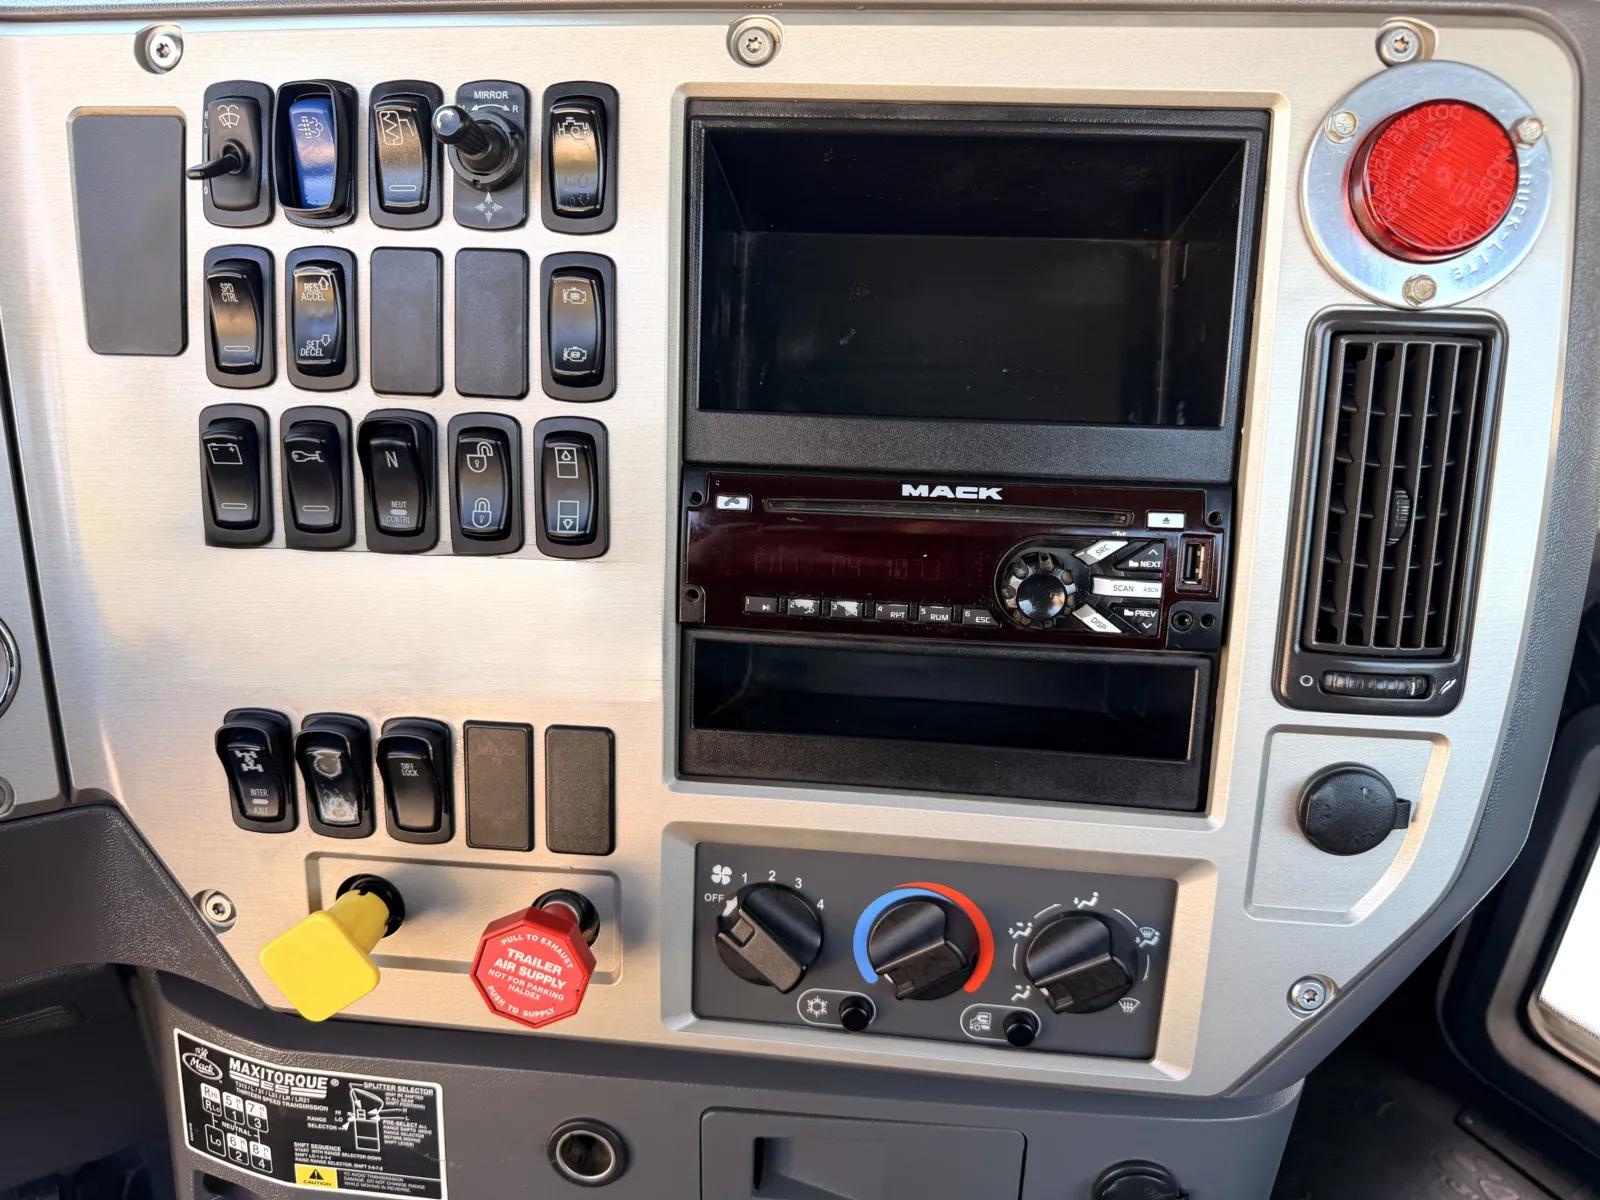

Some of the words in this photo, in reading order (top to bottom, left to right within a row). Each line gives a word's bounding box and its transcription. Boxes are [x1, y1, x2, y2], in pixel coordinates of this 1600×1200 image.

[474, 91, 508, 99] MIRROR
[220, 282, 234, 292] SPD
[222, 293, 238, 302] CTRL
[301, 292, 326, 300] ACCEL
[306, 340, 320, 348] SET
[300, 348, 324, 356] DECEL
[385, 451, 398, 468] N
[902, 484, 1003, 500] MACK
[1096, 544, 1110, 556] SRC
[1090, 617, 1107, 629] DISP
[742, 872, 748, 883] 1
[768, 870, 776, 881] 2
[795, 878, 802, 888] 3
[704, 893, 724, 902] OFF
[817, 899, 824, 910] 4
[501, 934, 524, 945] PULL
[541, 937, 574, 969] EXHAUST
[508, 948, 563, 976] TRAILER
[494, 958, 516, 972] AIR
[519, 965, 567, 990] SUPPLY
[488, 969, 506, 980] NOT
[508, 976, 526, 987] FOR
[527, 982, 564, 1001] PARKING
[508, 984, 542, 1000] HALDEX
[487, 985, 505, 1007] PUSH
[508, 1004, 519, 1013] TO
[523, 1006, 555, 1017] SUPPLY
[190, 1058, 215, 1076] Mack
[230, 1058, 328, 1089] MAXITORQUE
[364, 1082, 396, 1091] SPLITTER
[397, 1085, 434, 1096] SELECTOR
[226, 1096, 232, 1106] 5
[263, 1097, 280, 1105] SPEED
[282, 1101, 328, 1112] TRANSMISSION
[249, 1103, 254, 1112] 7
[232, 1111, 237, 1121] 1
[222, 1121, 251, 1136] NEUTRAL
[254, 1118, 261, 1128] 3
[231, 1137, 236, 1147] 6
[253, 1144, 259, 1154] 8
[236, 1151, 242, 1161] 2
[259, 1159, 265, 1168] 4
